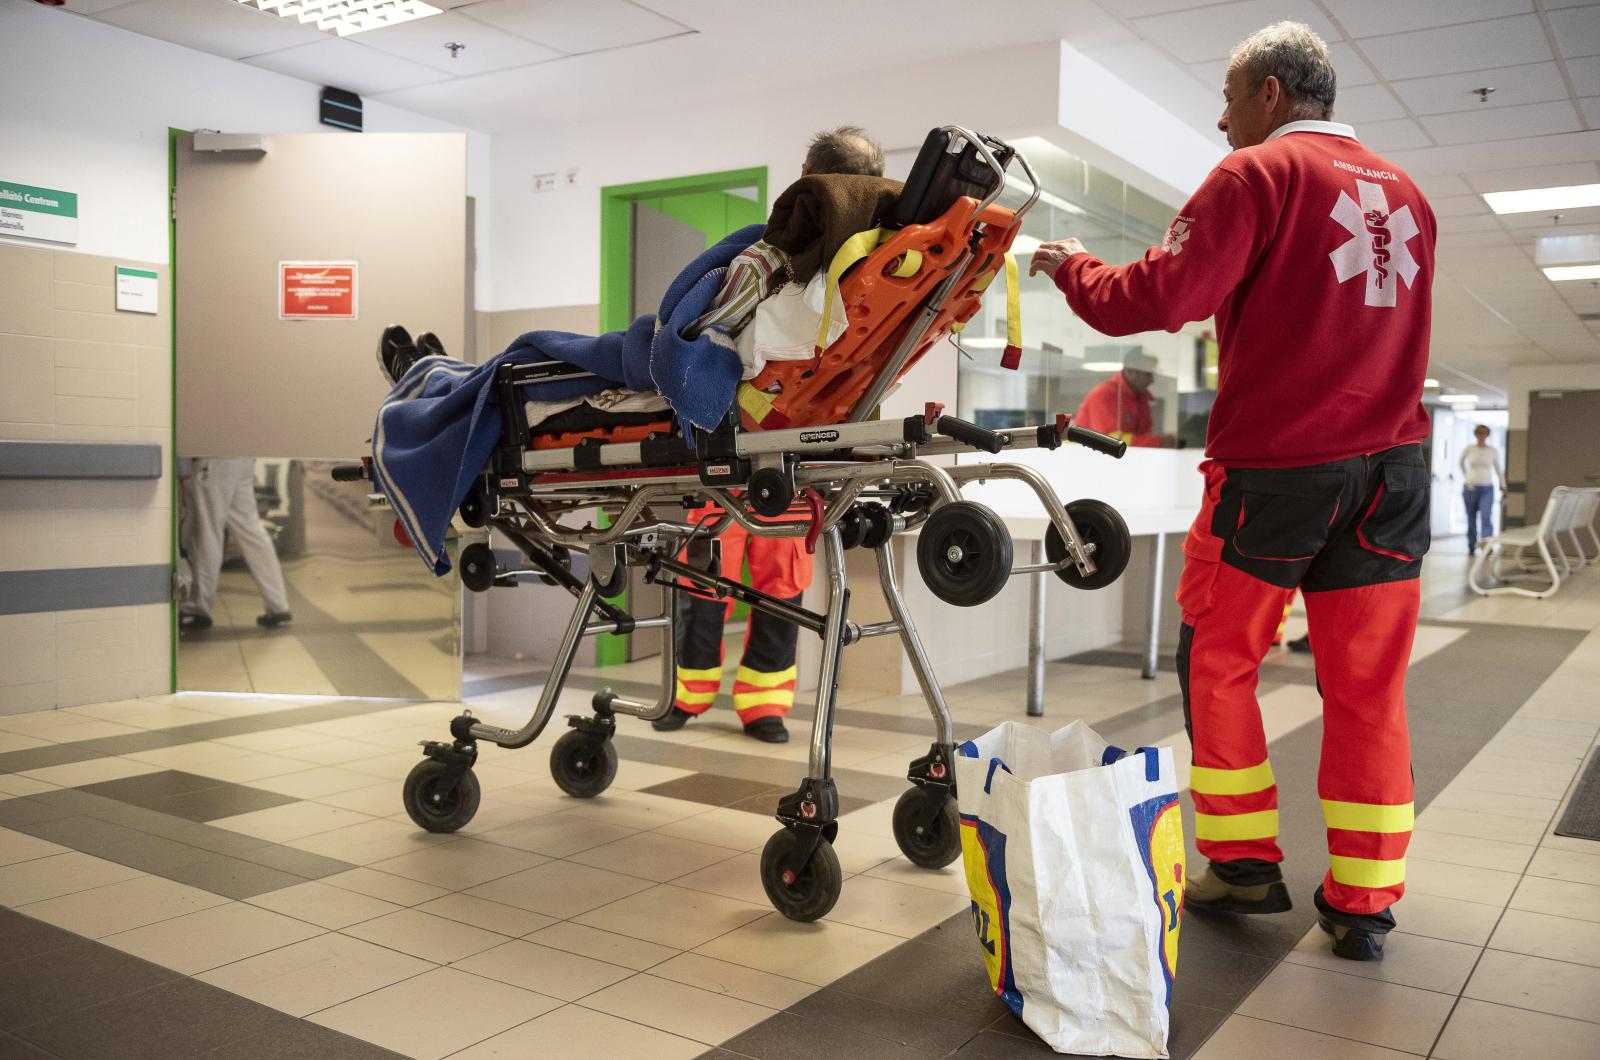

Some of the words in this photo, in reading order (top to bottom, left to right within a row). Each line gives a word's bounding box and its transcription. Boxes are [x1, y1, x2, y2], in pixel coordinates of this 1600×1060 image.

[1333, 159, 1400, 183] AMBULANCIA
[24, 193, 59, 208] Centrum
[801, 431, 837, 441] SPENCER
